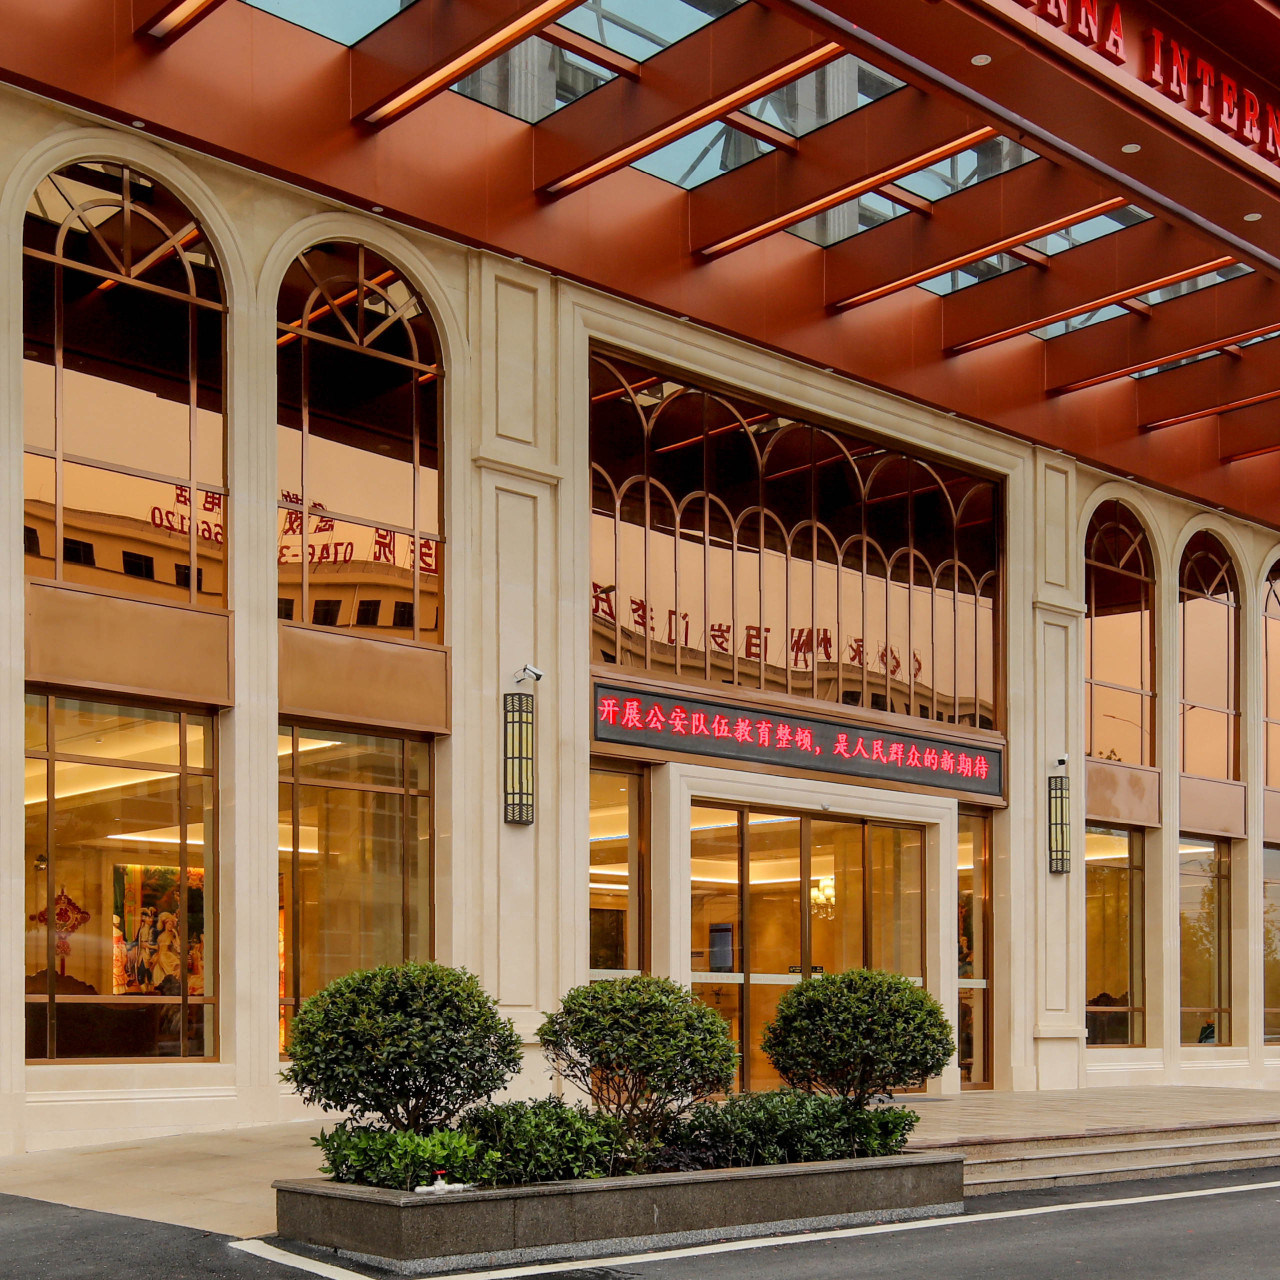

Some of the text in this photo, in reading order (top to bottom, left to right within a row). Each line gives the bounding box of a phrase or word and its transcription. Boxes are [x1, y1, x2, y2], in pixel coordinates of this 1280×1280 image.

[597, 697, 990, 780] 开展公安队伍教育整顿，是人民群众的新期待
